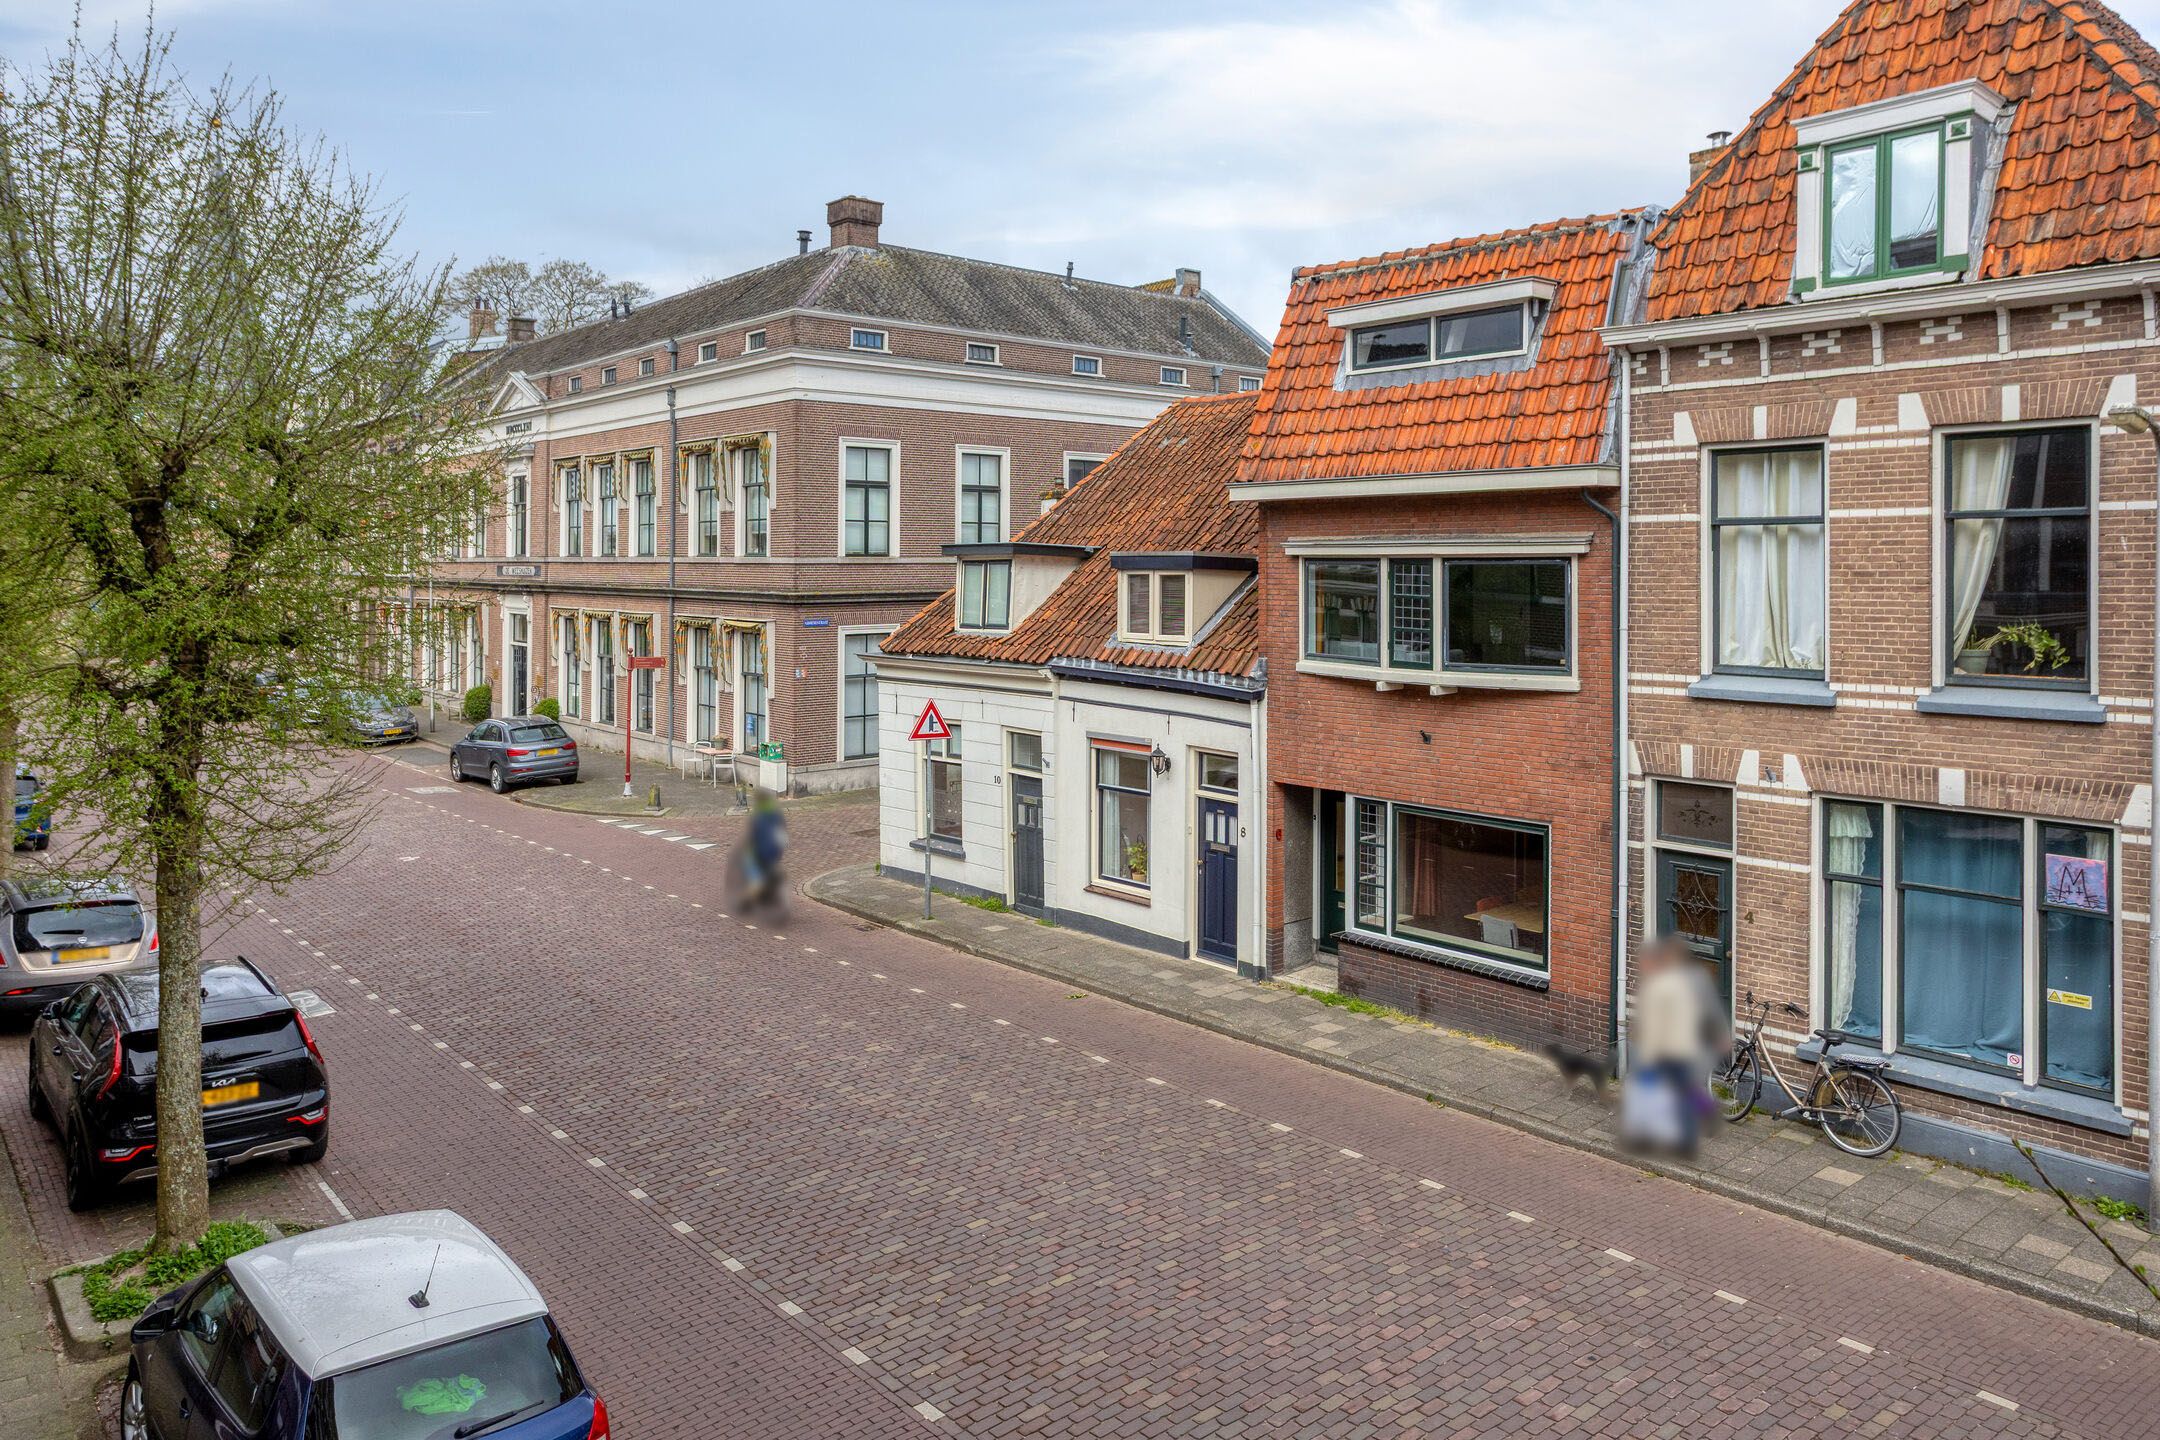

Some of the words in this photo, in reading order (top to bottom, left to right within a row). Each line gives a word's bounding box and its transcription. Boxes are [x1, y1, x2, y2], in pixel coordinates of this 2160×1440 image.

[994, 775, 1001, 784] 10
[1240, 826, 1246, 838] 8
[1744, 911, 1754, 924] 4
